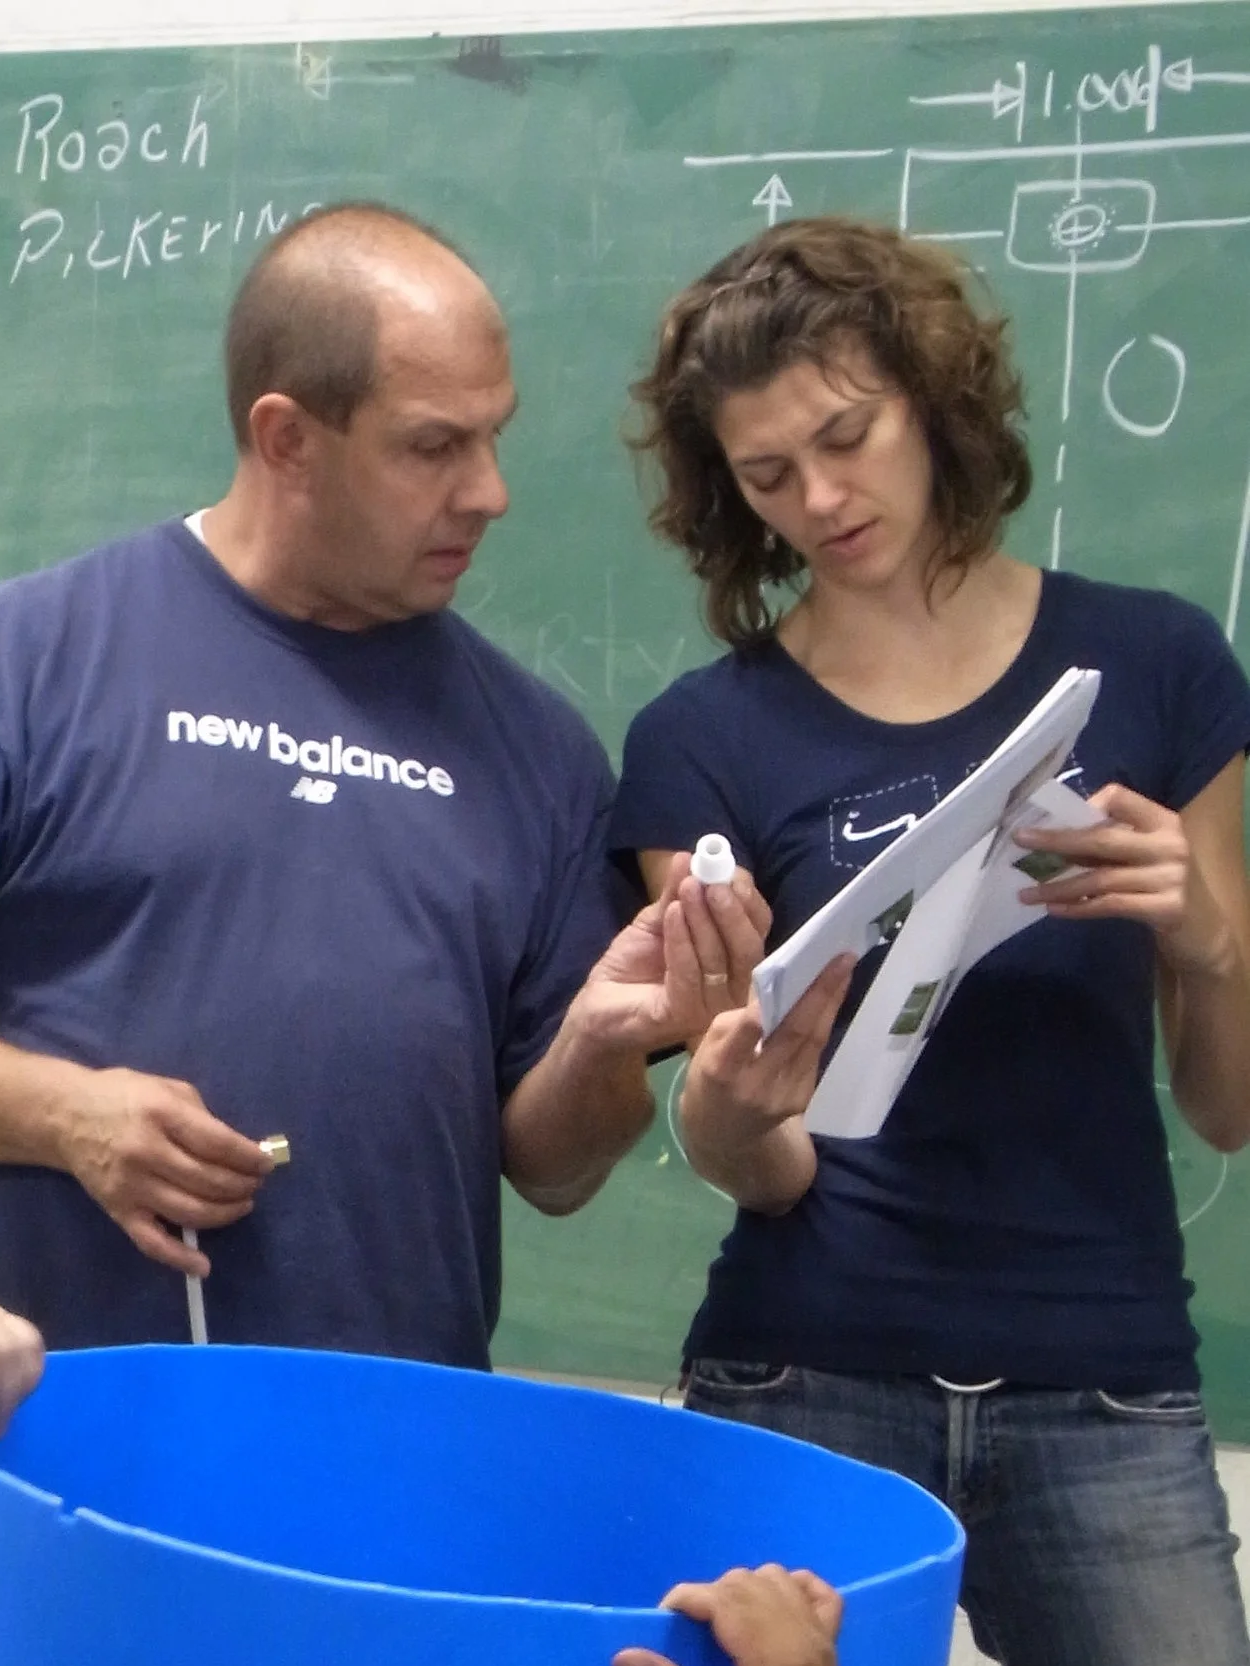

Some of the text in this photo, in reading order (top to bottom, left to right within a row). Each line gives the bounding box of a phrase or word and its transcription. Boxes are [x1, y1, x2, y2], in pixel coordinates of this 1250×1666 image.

[16, 92, 209, 182] Roach
[167, 711, 456, 797] new balance
[290, 776, 338, 804] NB
